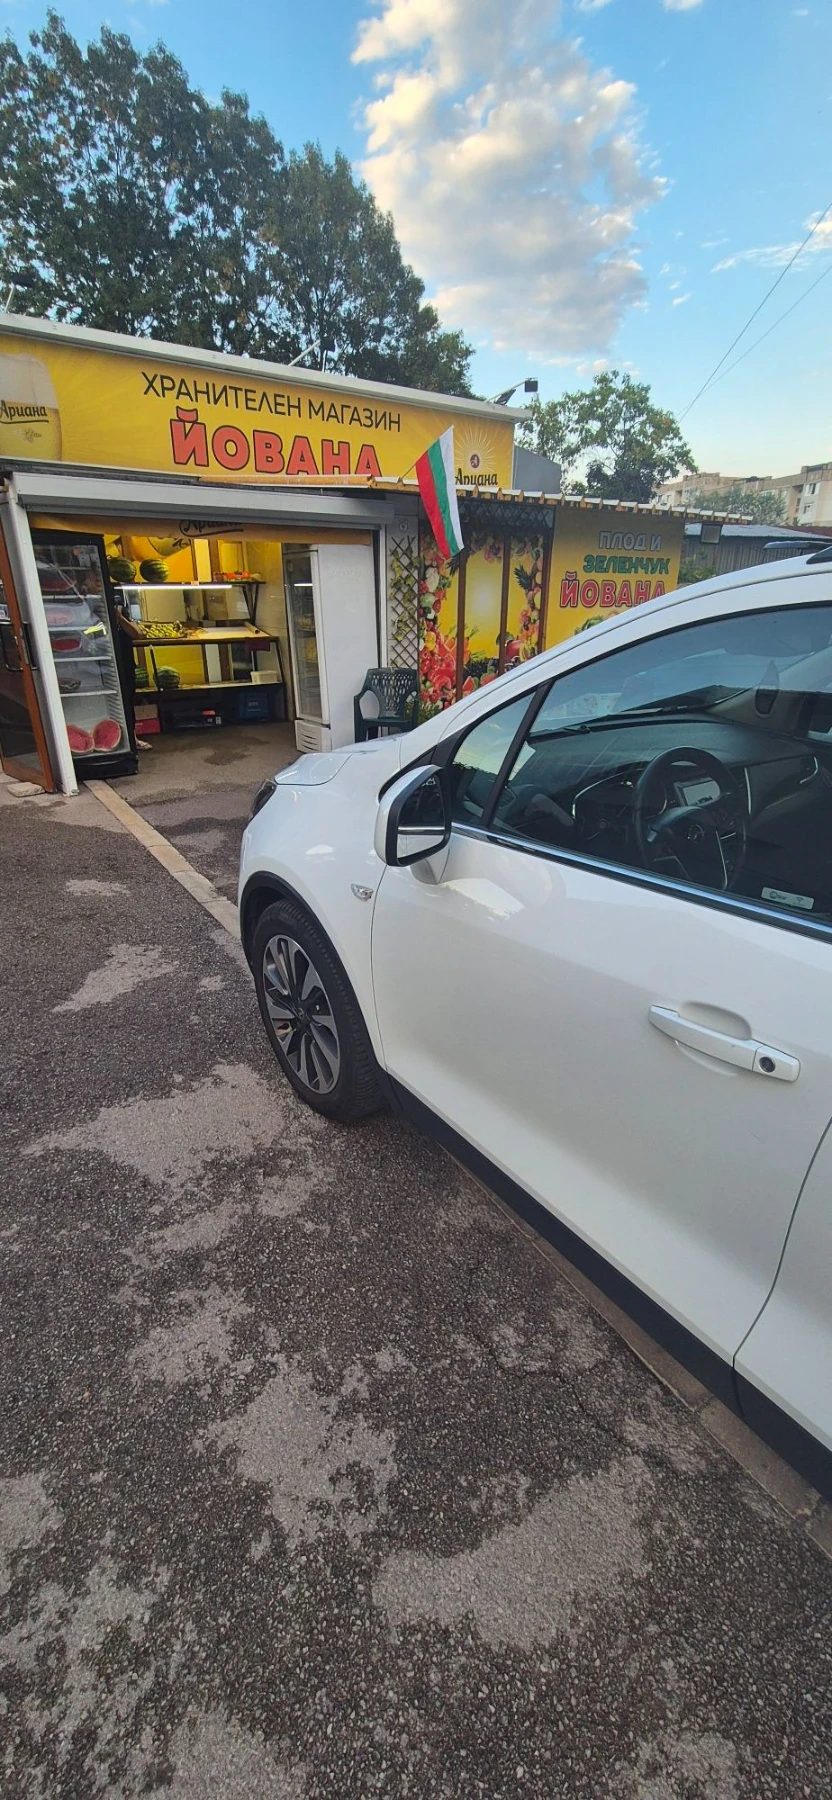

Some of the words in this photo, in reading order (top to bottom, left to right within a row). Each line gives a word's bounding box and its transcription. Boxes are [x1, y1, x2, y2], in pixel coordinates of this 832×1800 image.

[141, 371, 301, 418] ХРАНИТЕЛЕН
[308, 399, 401, 432] МАГАЗИН
[170, 406, 382, 477] ЙОВАНА
[599, 530, 646, 551] ПЛОД
[650, 534, 662, 552] И
[583, 554, 670, 574] ЗЕЛЕНЧУК
